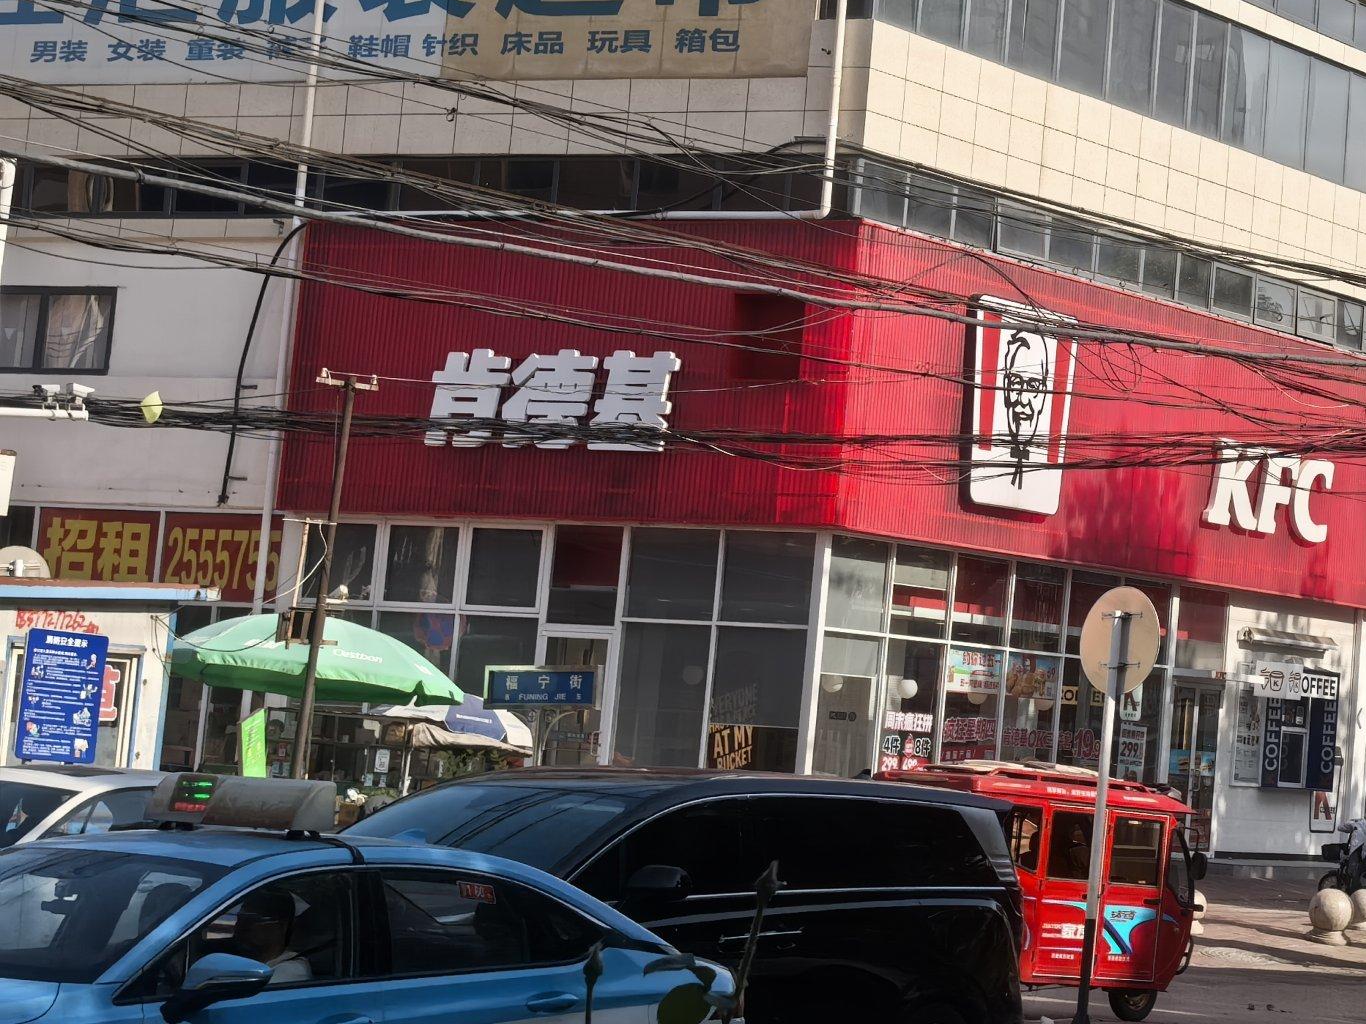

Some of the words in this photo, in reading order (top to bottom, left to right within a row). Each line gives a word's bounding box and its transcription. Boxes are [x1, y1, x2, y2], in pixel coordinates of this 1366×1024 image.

[30, 40, 88, 63] 男装
[107, 39, 167, 62] 女装
[348, 34, 411, 58] 鞋帽
[422, 32, 479, 57] 针织
[500, 31, 565, 56] 床品
[587, 29, 652, 54] 玩具
[674, 27, 740, 54] 箱包
[425, 349, 681, 451] 肯德基
[1203, 436, 1335, 543] KFC
[44, 517, 151, 582] 招租
[506, 675, 582, 690] 福宁街
[518, 693, 549, 701] FUNING
[554, 693, 566, 701] JIE
[1301, 676, 1336, 697] OFFEE
[714, 728, 730, 759] AT
[734, 726, 754, 749] MY
[1264, 698, 1282, 771] COFFEE
[1320, 701, 1336, 774] COFFEE
